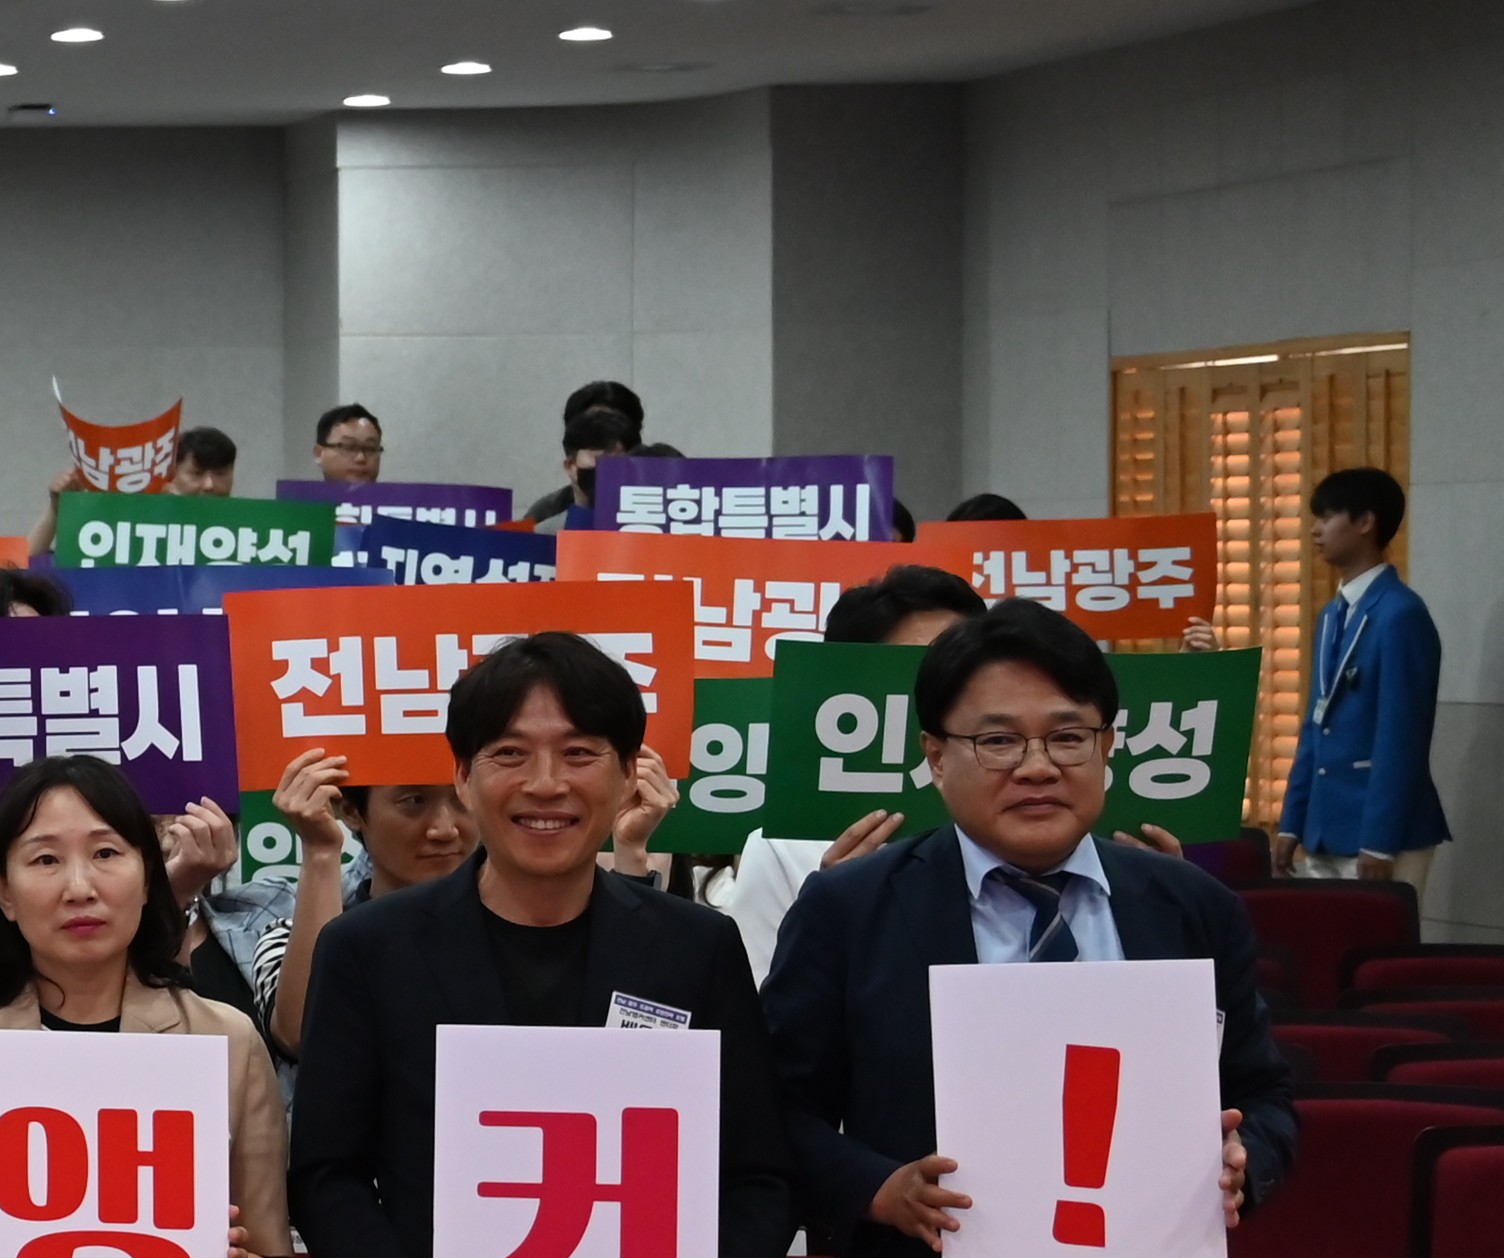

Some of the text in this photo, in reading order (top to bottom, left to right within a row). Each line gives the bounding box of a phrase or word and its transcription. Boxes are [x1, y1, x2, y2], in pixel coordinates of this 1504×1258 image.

[616, 483, 870, 541] 통합특별시
[597, 572, 841, 662] 남광
[815, 692, 1218, 800] 인성
[1051, 1043, 1121, 1247] !
